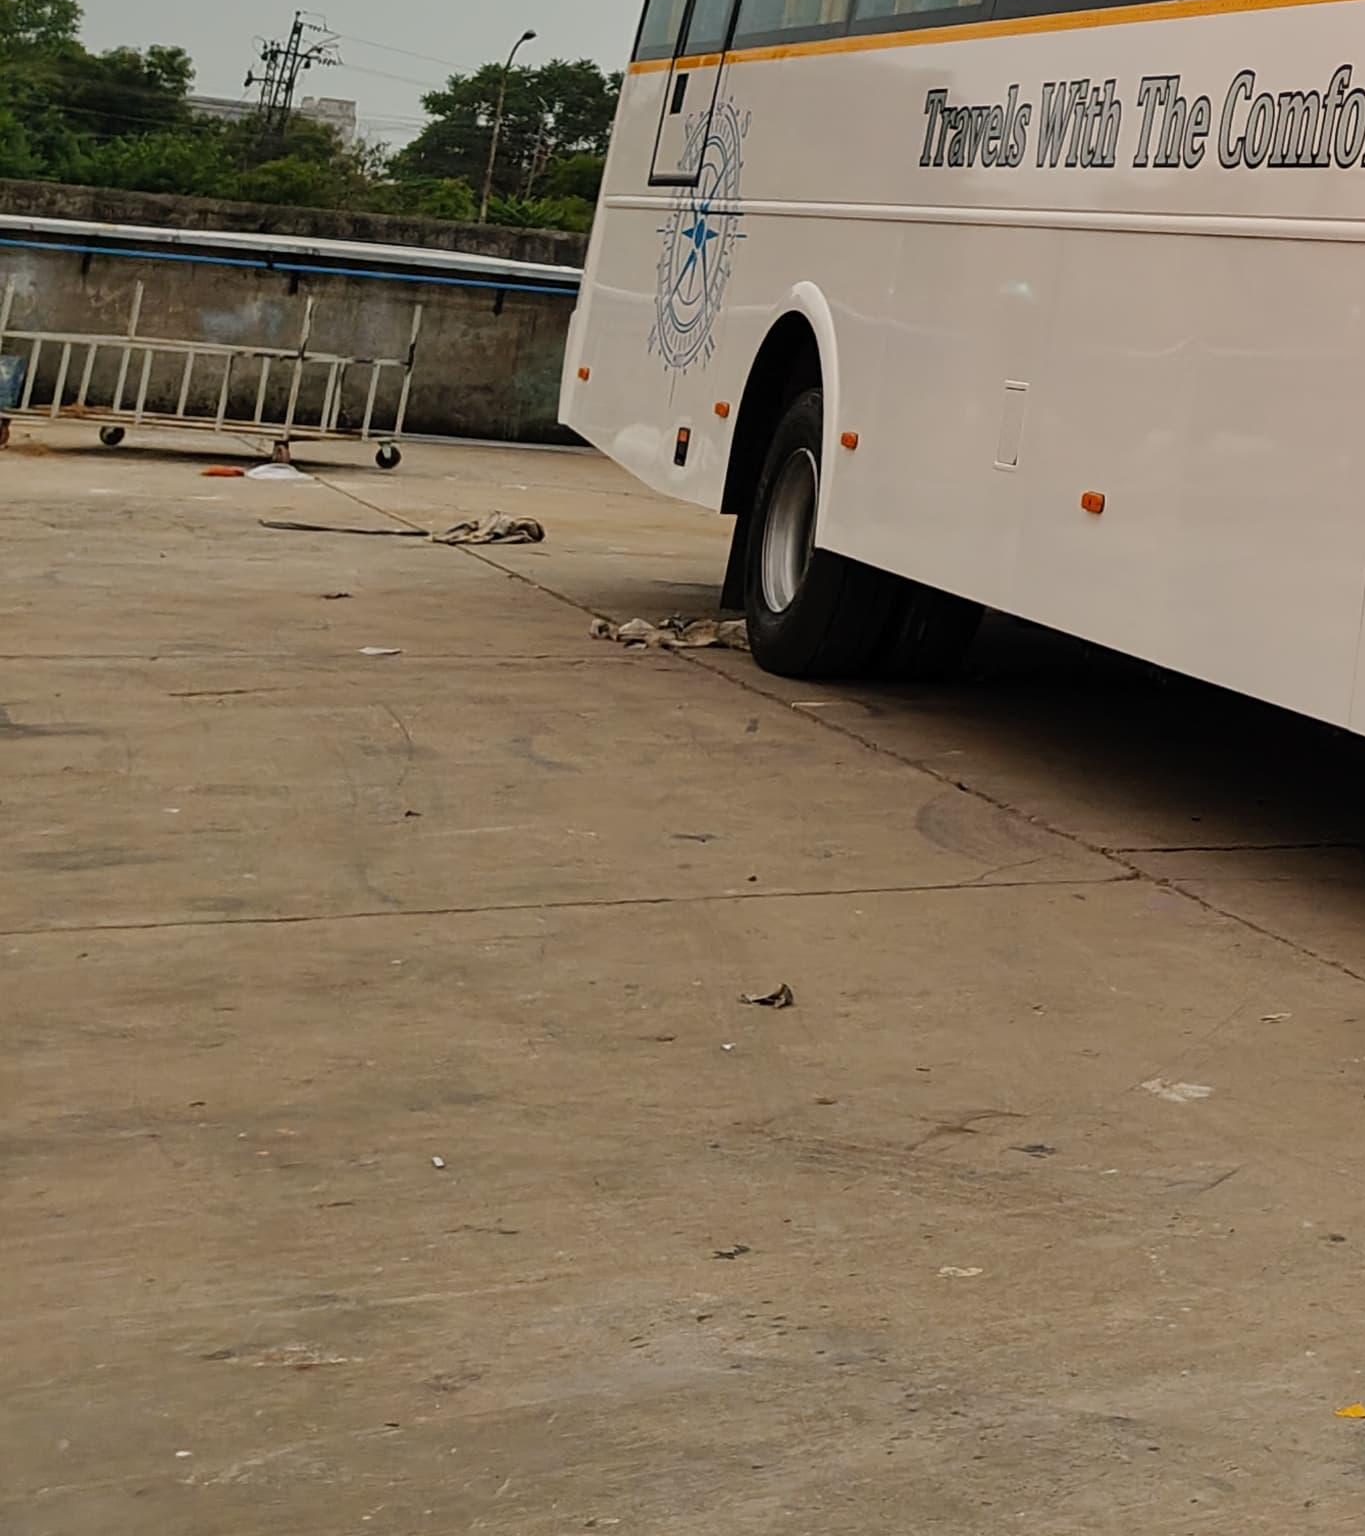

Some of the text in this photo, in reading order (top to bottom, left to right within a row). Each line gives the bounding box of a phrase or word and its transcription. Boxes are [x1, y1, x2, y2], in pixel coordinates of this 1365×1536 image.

[919, 84, 1032, 168] Travels
[1036, 78, 1122, 168] With
[1132, 75, 1212, 169] The
